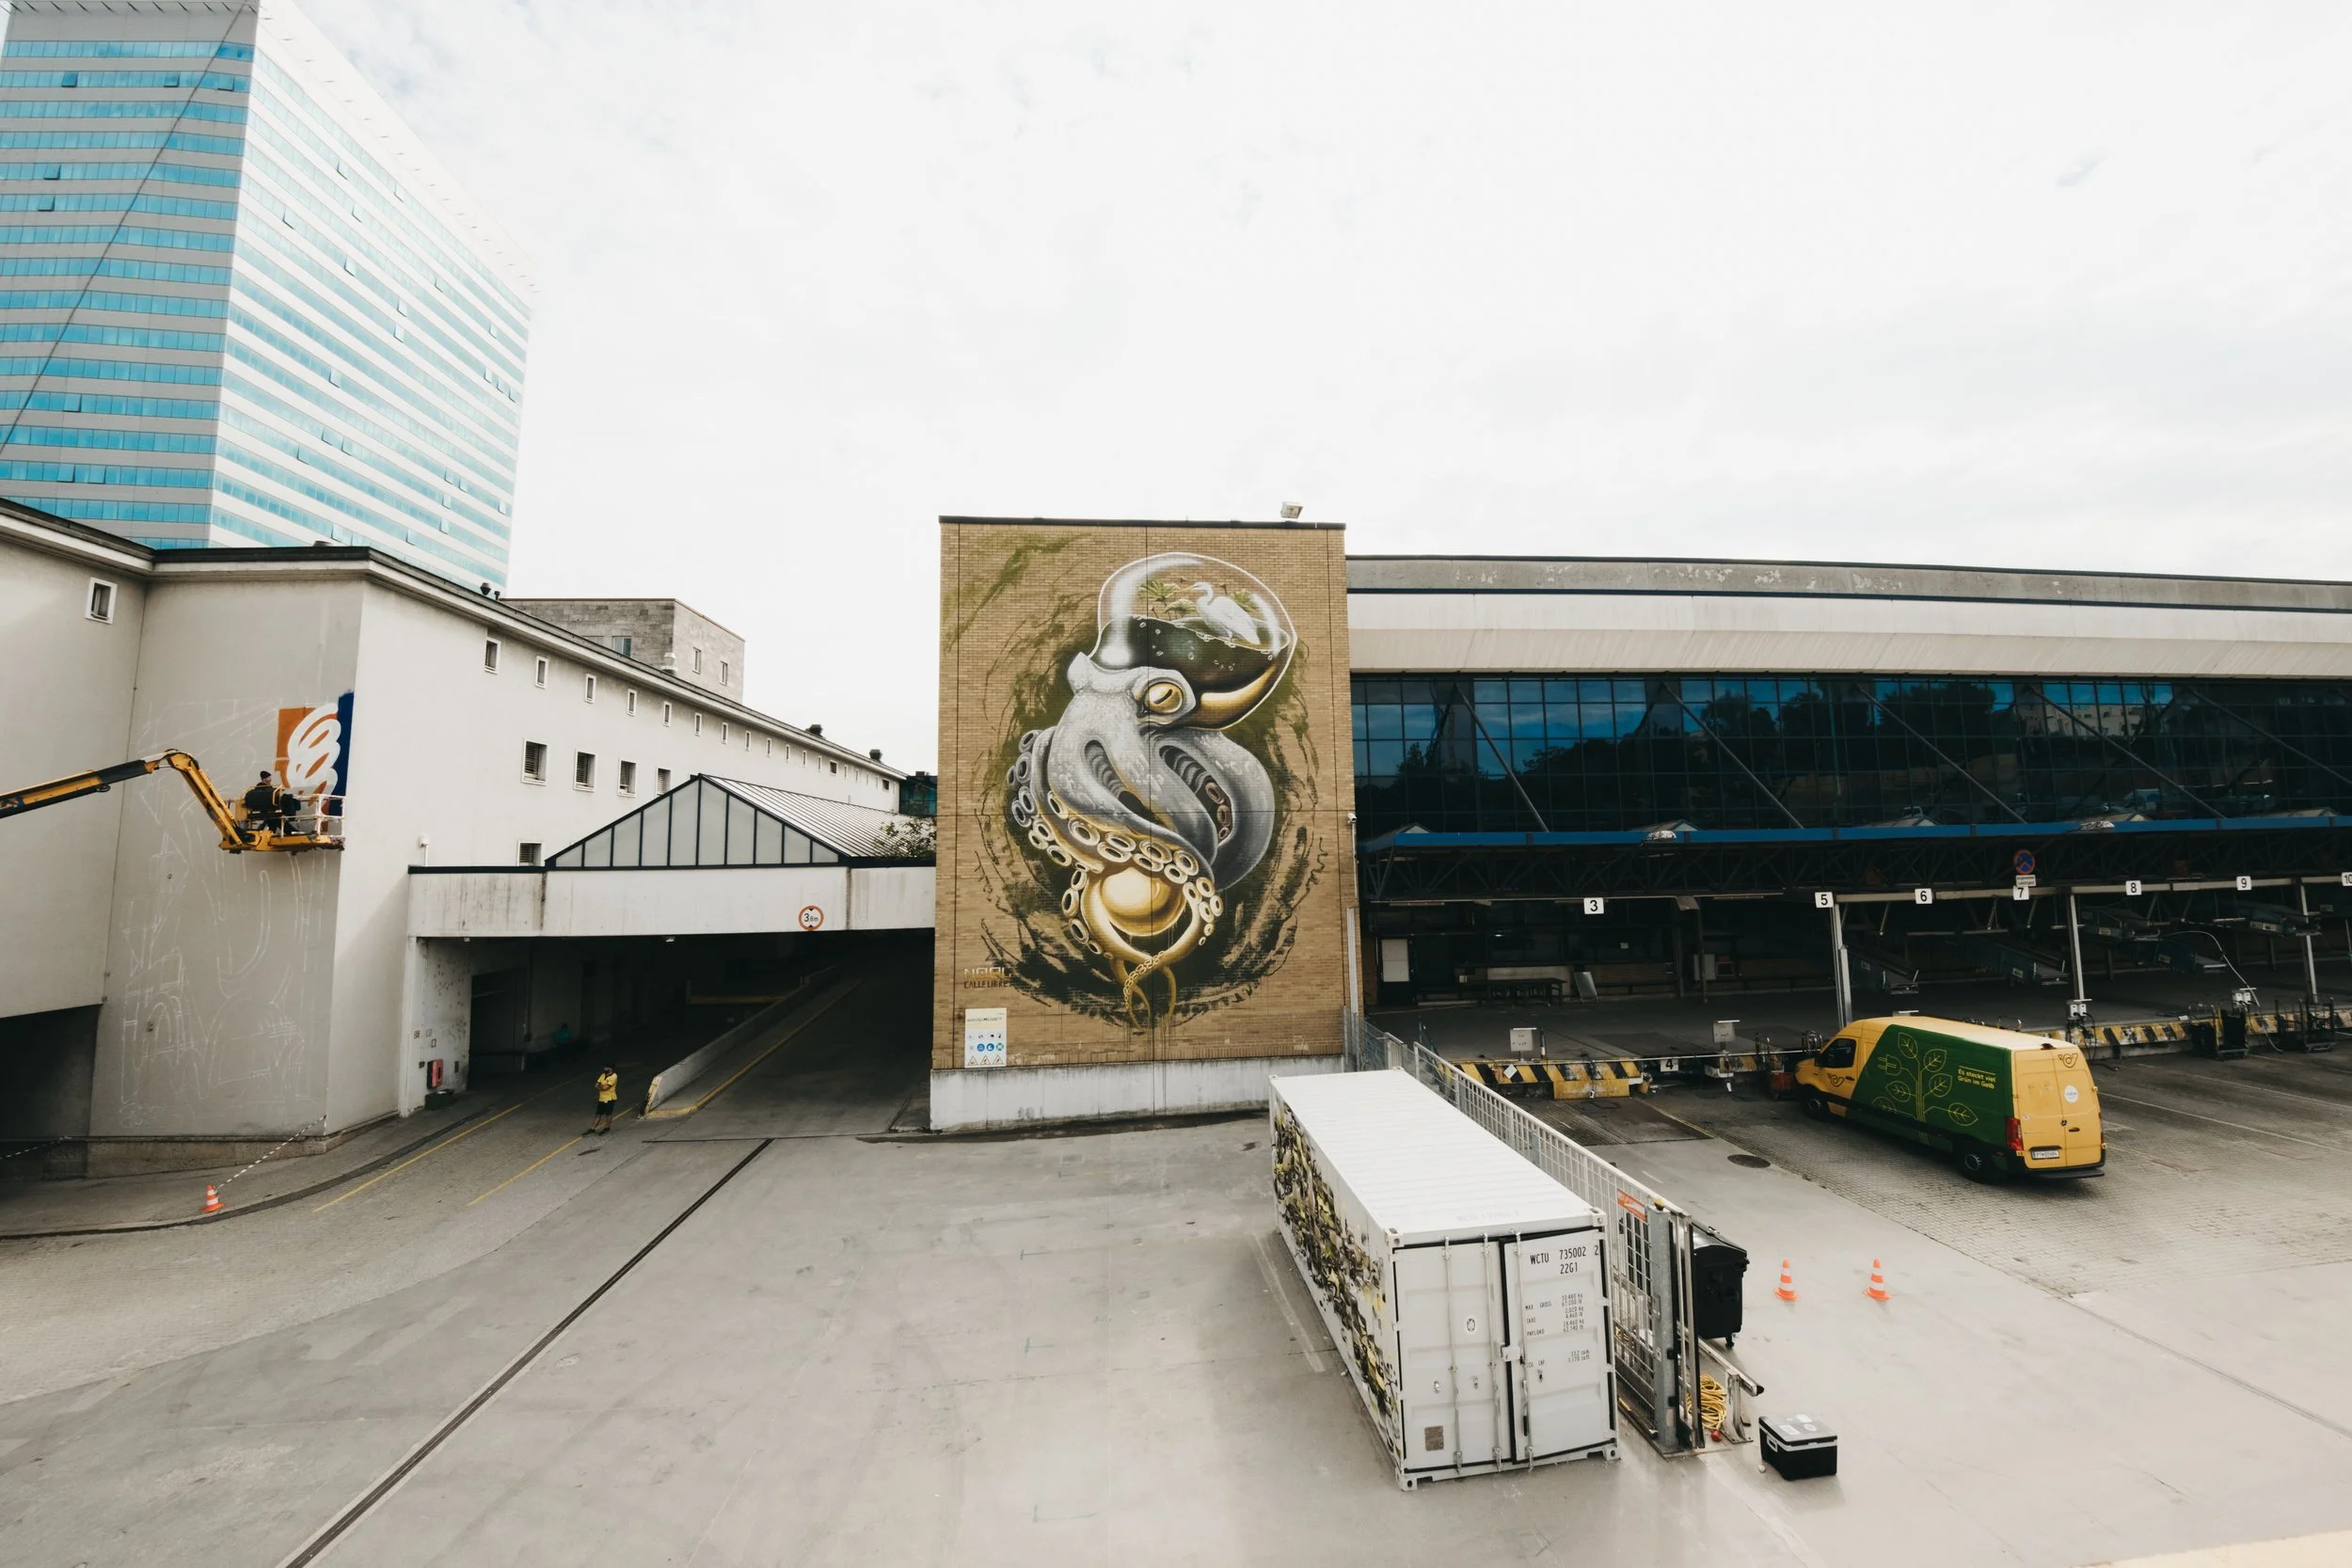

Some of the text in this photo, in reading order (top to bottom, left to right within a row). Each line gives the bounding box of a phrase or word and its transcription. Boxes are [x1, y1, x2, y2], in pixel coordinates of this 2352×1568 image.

[2131, 882, 2137, 894] 8
[2241, 878, 2248, 889] 9
[1920, 890, 1928, 902] 6
[2017, 887, 2024, 898] 7
[1590, 899, 1598, 912] 3
[1820, 894, 1828, 906] 5
[1665, 1059, 1674, 1070] 4
[1559, 1246, 1586, 1260] 735002
[1594, 1244, 1599, 1256] 2
[1560, 1262, 1578, 1275] 22G1
